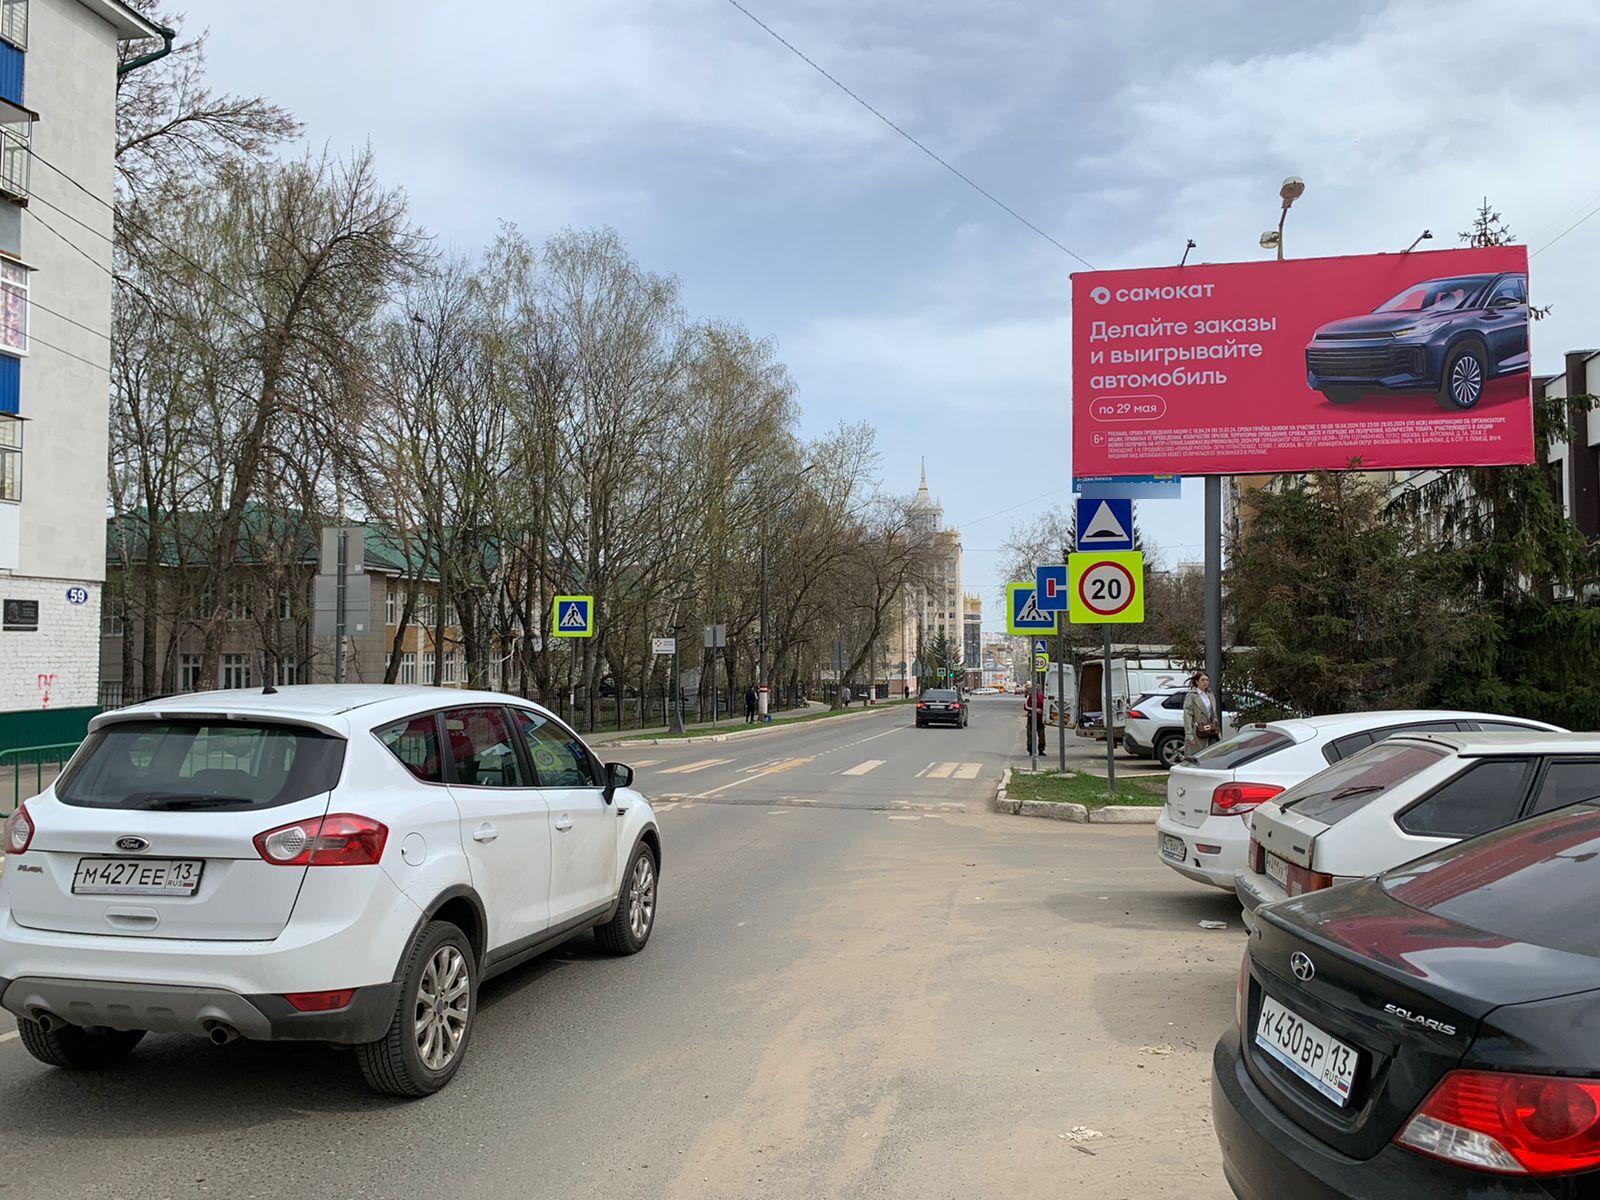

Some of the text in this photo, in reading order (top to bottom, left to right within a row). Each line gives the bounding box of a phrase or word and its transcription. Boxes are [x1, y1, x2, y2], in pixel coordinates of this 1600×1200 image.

[1116, 284, 1214, 302] самокат
[1090, 317, 1276, 342] Делайте заказы
[1090, 339, 1263, 365] и выигрывайте
[1090, 367, 1227, 389] автомобиль
[1099, 404, 1157, 414] по 29 мая
[1094, 434, 1104, 444] 6+
[70, 590, 84, 602] 59
[1092, 578, 1122, 600] 20
[120, 839, 140, 849] Ford
[173, 864, 193, 880] 13
[1384, 1004, 1456, 1036] SOLARIS
[1332, 1045, 1350, 1075] 13
[1324, 1068, 1338, 1086] RUS
